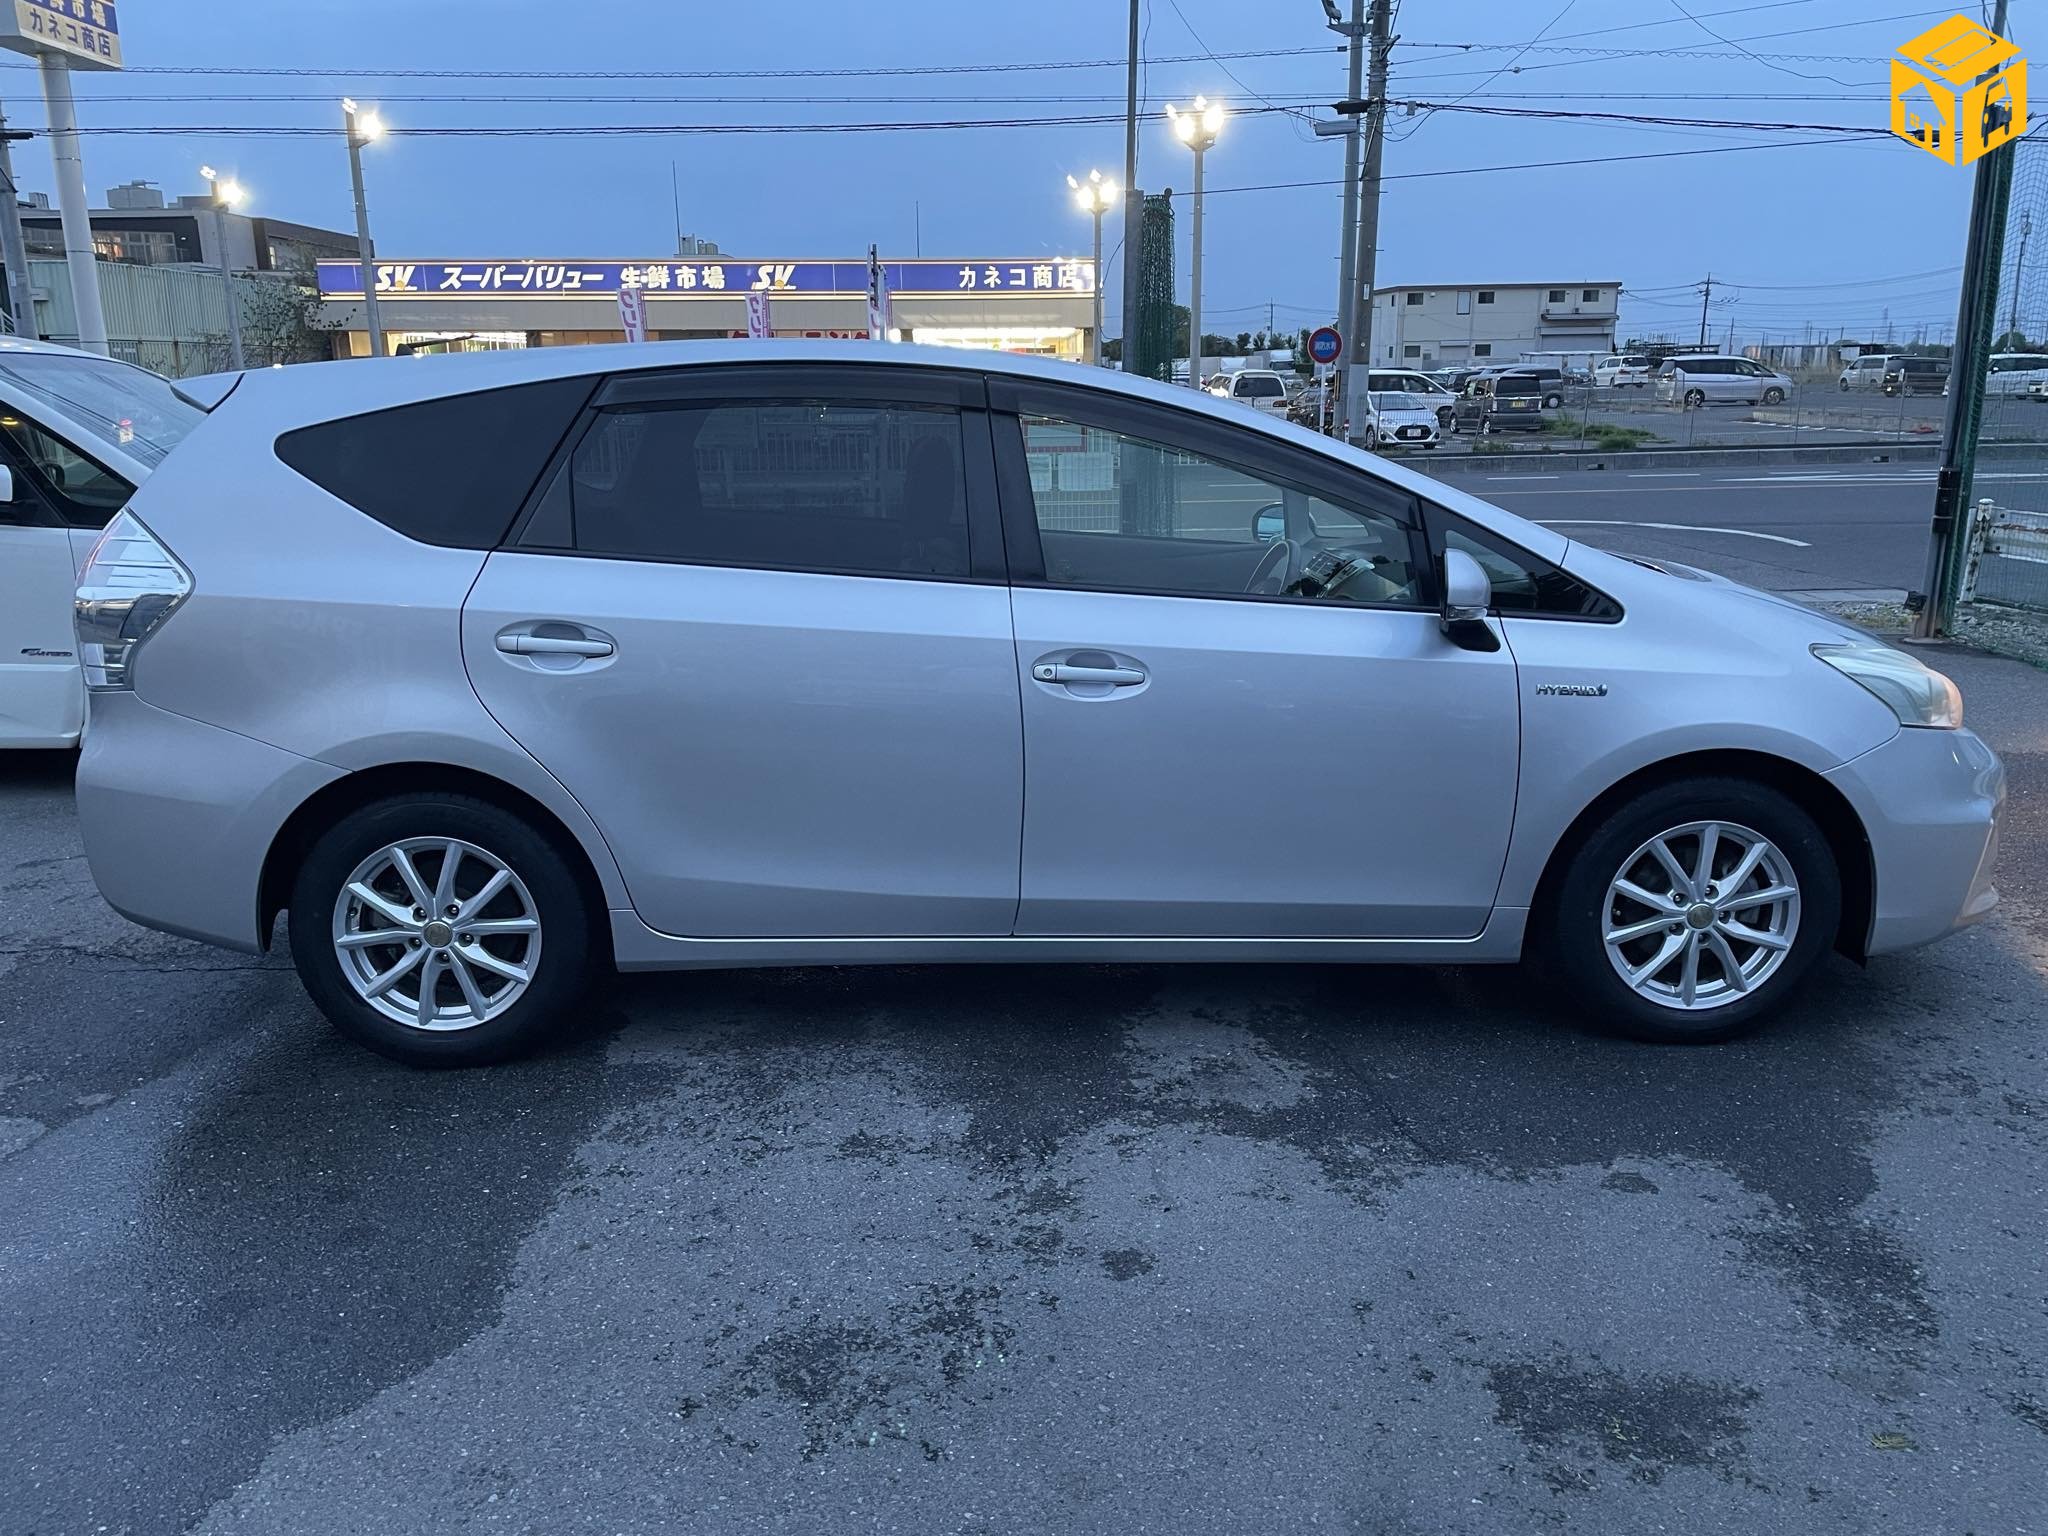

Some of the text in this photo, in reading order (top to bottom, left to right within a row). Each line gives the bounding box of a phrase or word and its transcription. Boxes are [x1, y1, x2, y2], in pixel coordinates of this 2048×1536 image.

[29, 7, 111, 56] カネコ商店
[440, 265, 604, 289] スーパーバリュー
[620, 265, 725, 289] 生鮮市場
[958, 265, 1077, 288] カネコ商店
[1536, 684, 1599, 696] HYBRID
